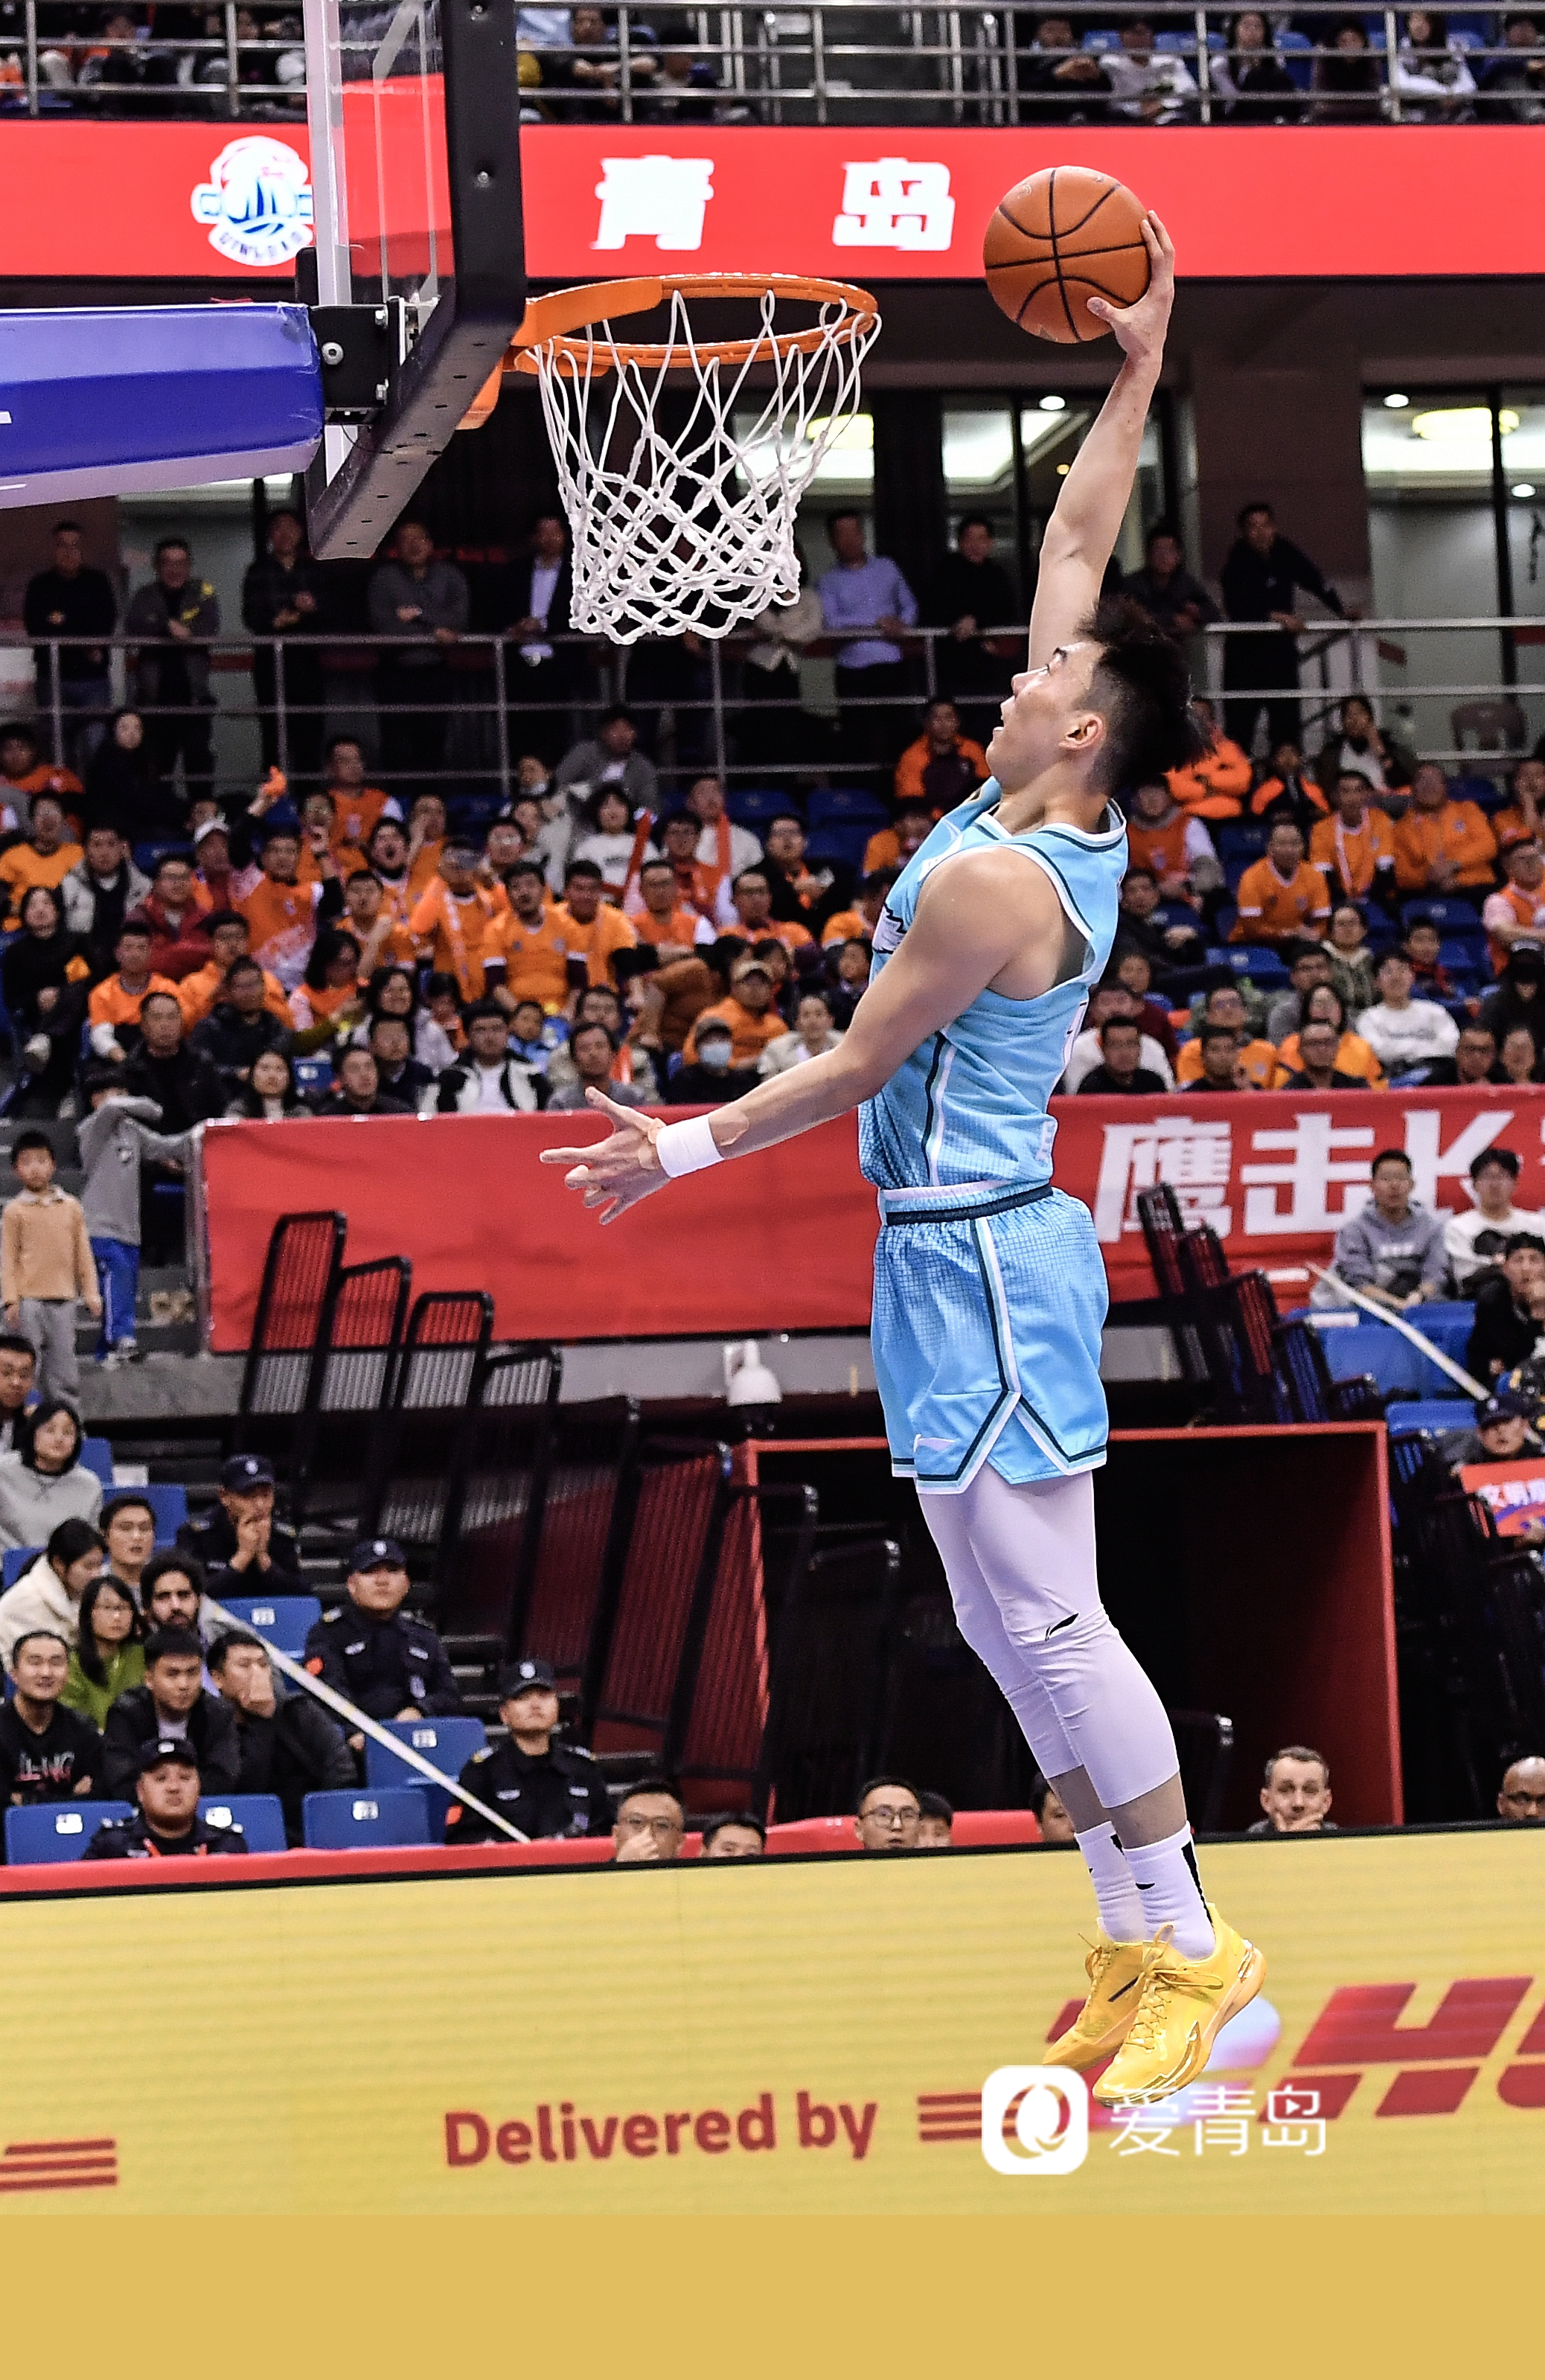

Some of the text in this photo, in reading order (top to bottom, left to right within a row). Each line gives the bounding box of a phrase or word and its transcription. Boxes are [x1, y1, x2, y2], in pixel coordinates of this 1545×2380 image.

[1094, 1110, 1545, 1242] 鹰击长
[446, 2090, 877, 2166] Delivered by
